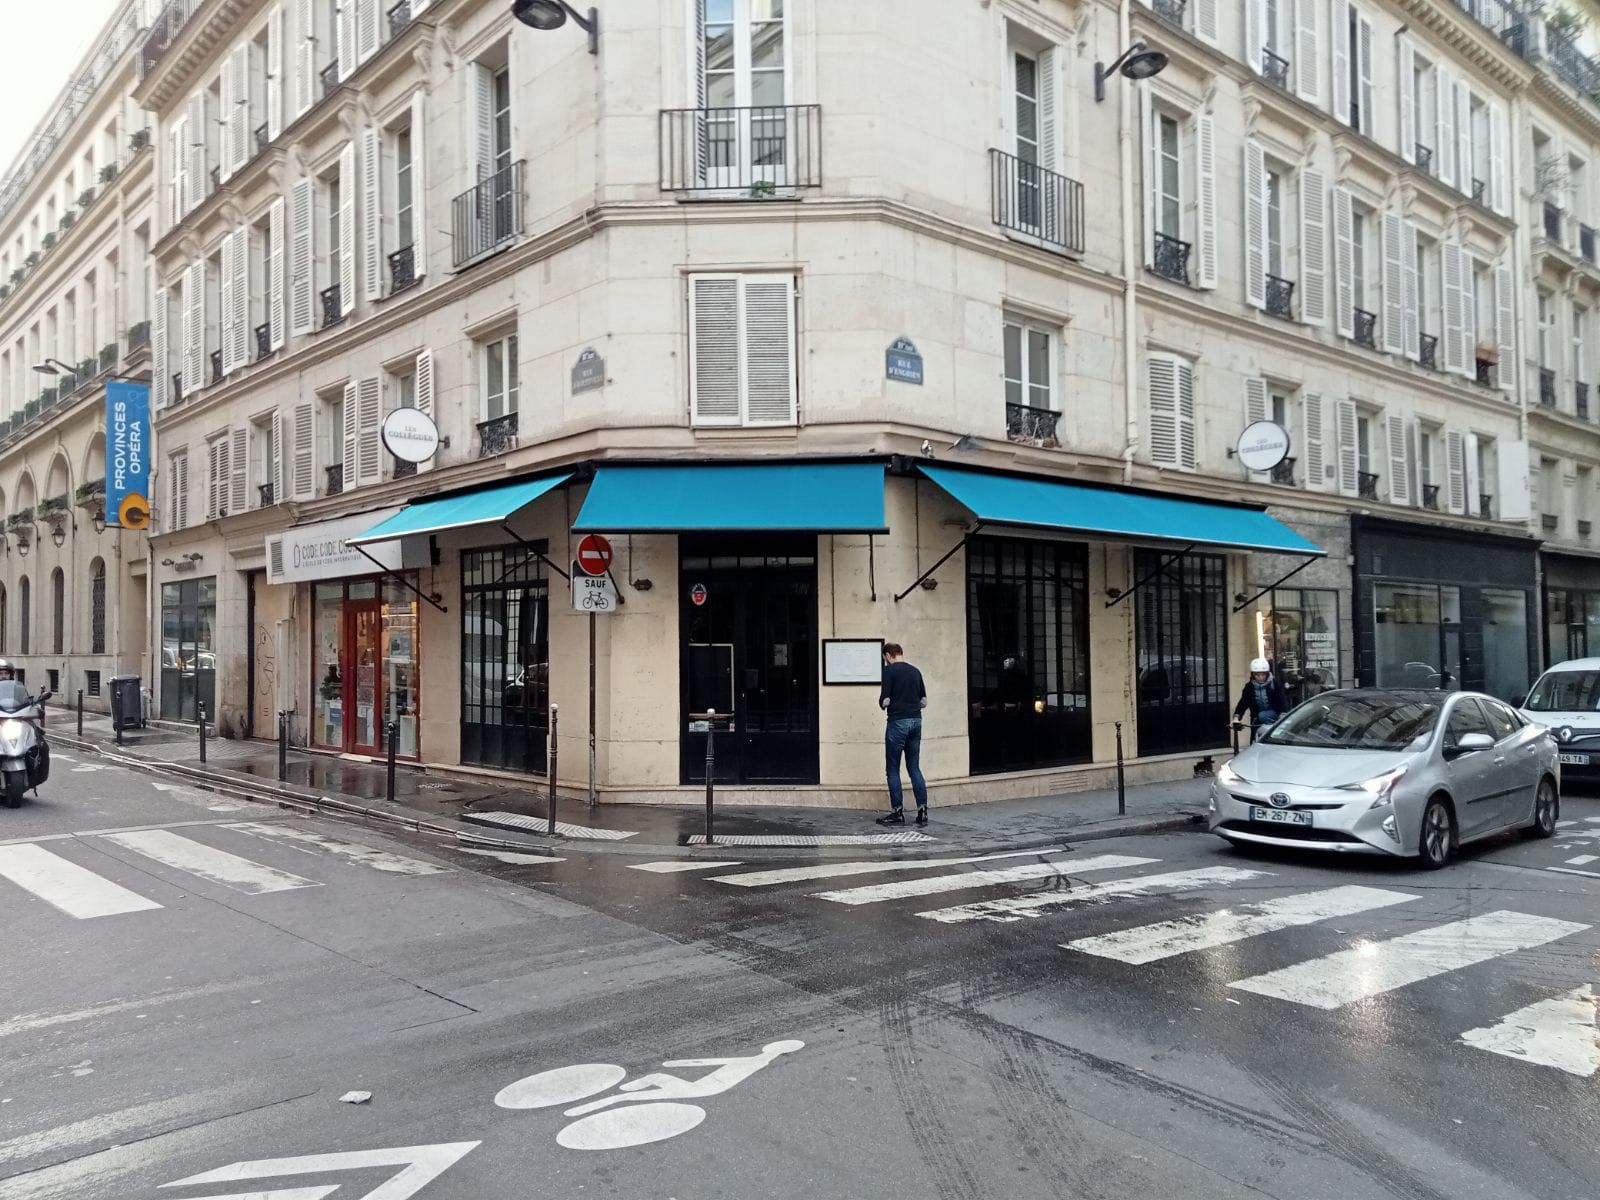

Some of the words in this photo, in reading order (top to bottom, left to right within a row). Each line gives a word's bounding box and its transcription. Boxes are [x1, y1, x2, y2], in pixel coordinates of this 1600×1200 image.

[115, 401, 127, 490] PROVINCES
[129, 421, 141, 475] OPÉRA
[584, 579, 607, 588] SAUF
